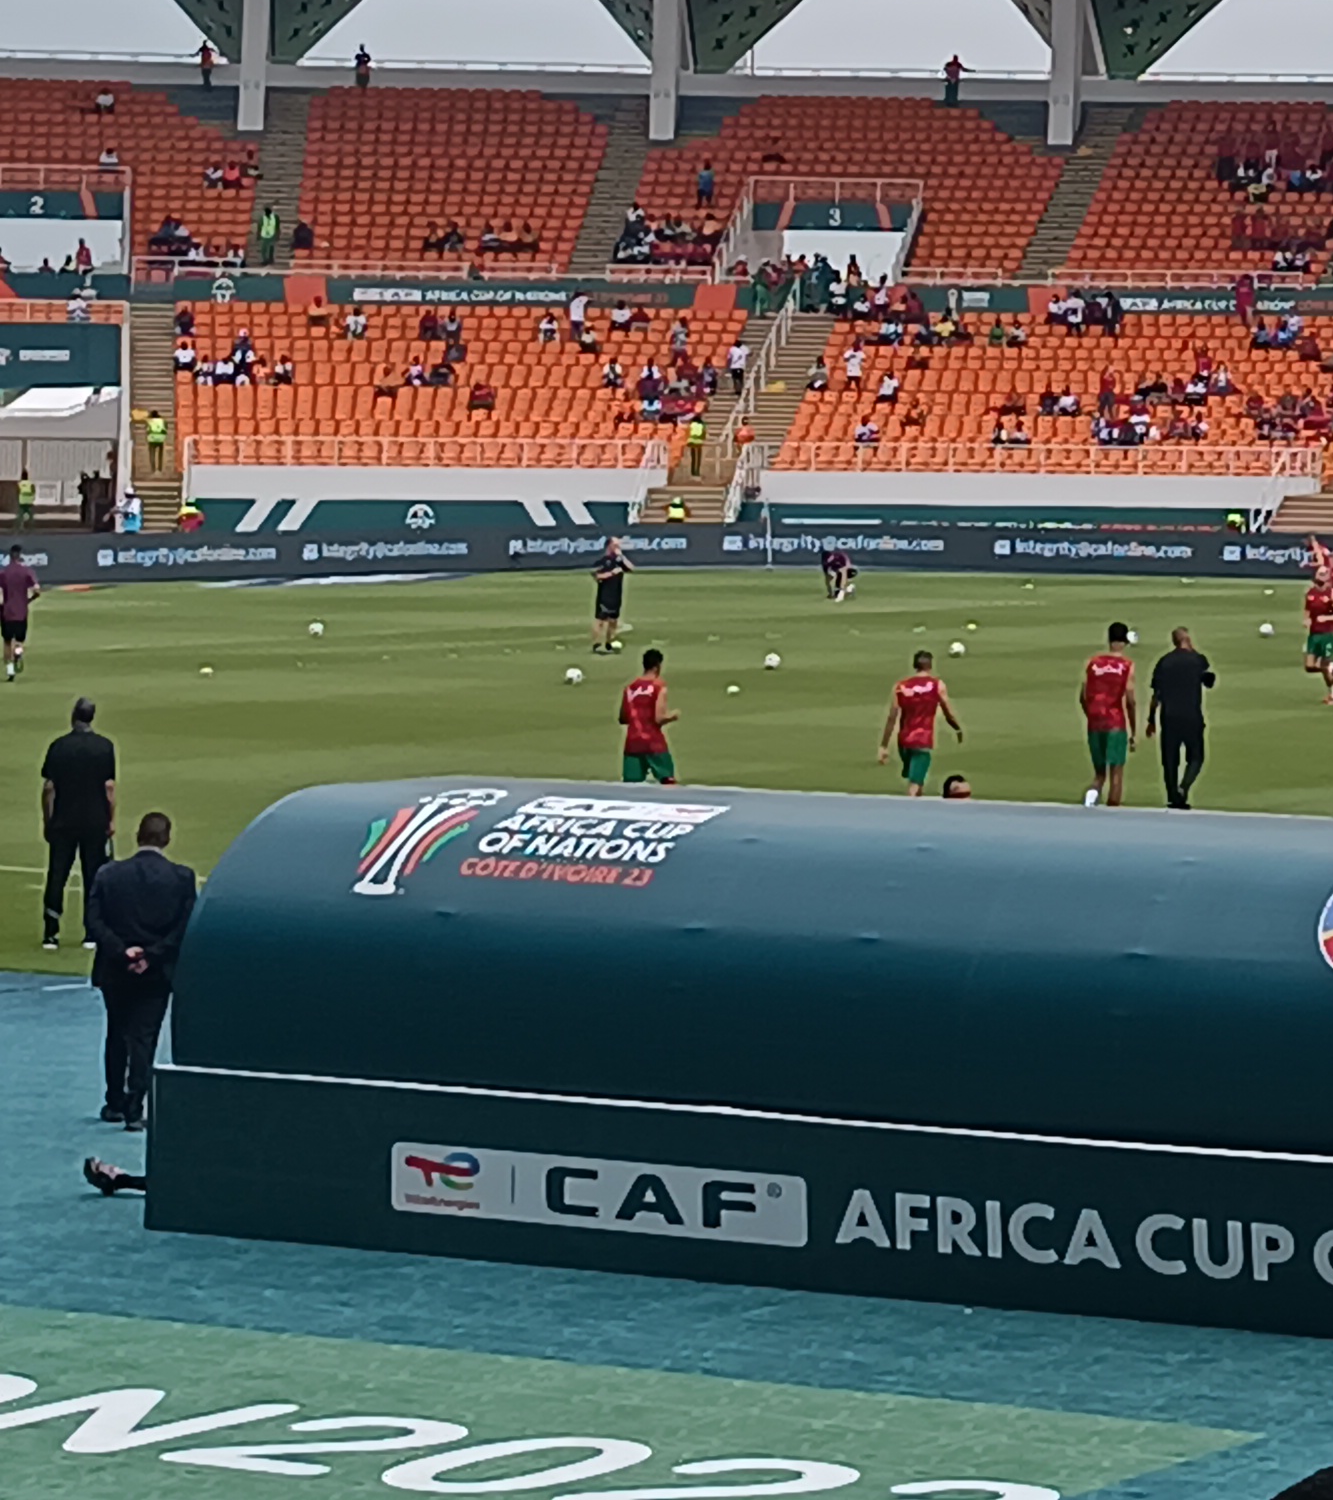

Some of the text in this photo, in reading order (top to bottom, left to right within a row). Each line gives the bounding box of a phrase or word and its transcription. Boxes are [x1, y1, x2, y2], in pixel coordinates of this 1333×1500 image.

[494, 813, 695, 840] AFRICA CUP
[478, 831, 676, 864] OF NATIONS
[461, 856, 518, 878] CÔTE
[518, 861, 623, 885] D'IVOIRE
[545, 1165, 757, 1229] CAF
[834, 1188, 1122, 1269] AFRICA
[1134, 1213, 1296, 1282] CUP
